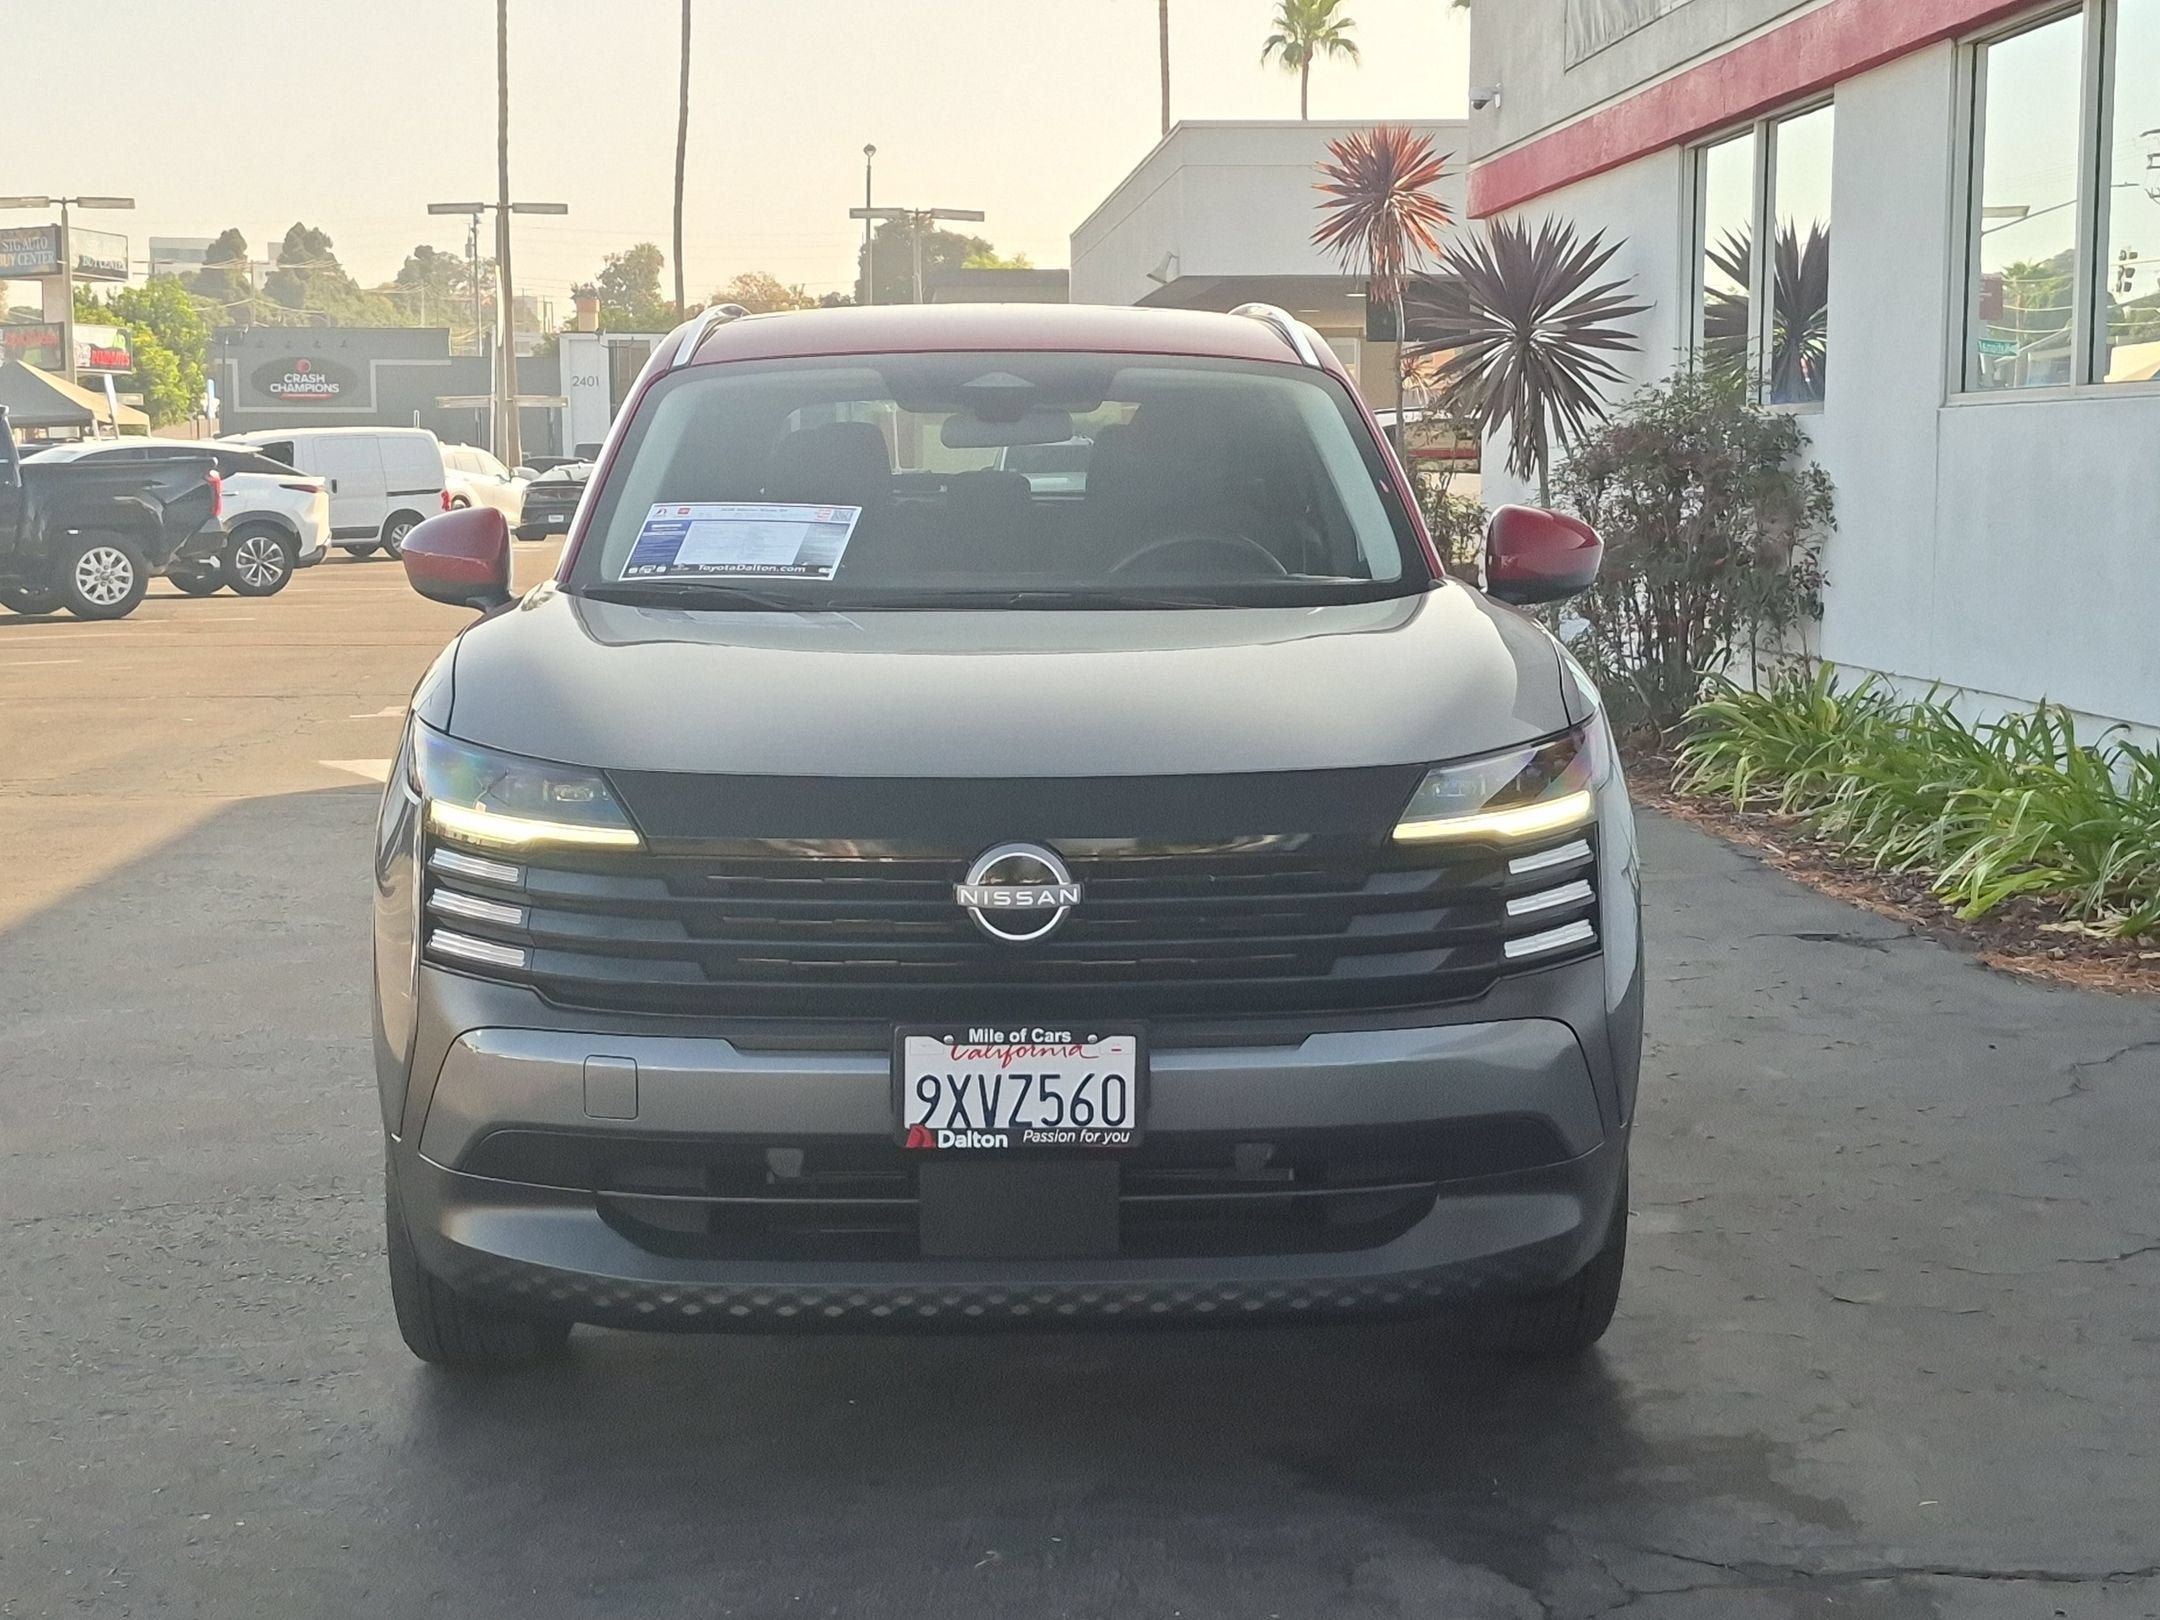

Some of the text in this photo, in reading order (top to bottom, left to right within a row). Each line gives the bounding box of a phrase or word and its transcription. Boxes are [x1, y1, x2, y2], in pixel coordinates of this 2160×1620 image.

[22, 236, 48, 251] AUTO
[0, 250, 55, 267] UY CENTER
[284, 373, 326, 383] CRASH
[571, 375, 600, 387] 2401
[270, 383, 340, 393] CHAMPIONS
[697, 563, 806, 574] ToyotaDalton.com
[959, 888, 1078, 906] NISSAN
[968, 1028, 1072, 1043] Mile of Cars
[950, 1044, 1099, 1069] California
[915, 1073, 1127, 1128] 9XVZ560
[938, 1130, 1009, 1149] Dalton
[1022, 1128, 1130, 1144] Passion for you
